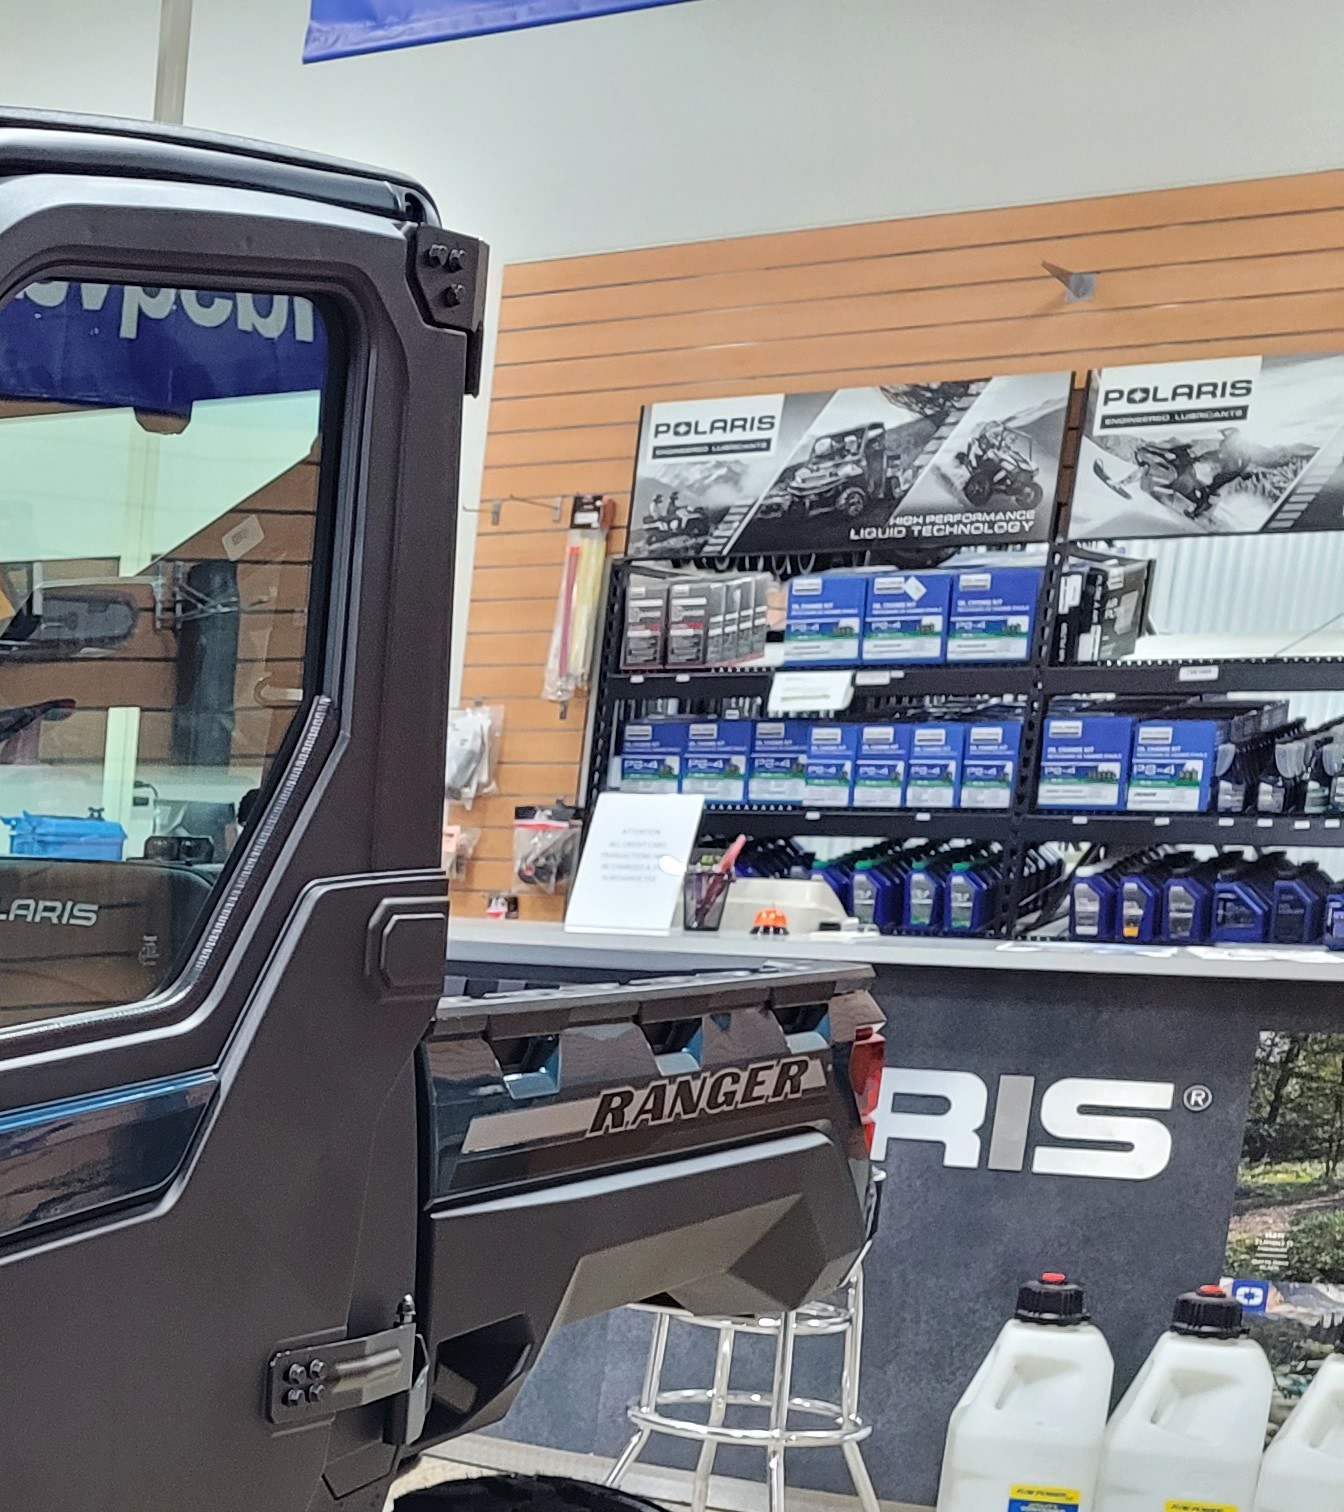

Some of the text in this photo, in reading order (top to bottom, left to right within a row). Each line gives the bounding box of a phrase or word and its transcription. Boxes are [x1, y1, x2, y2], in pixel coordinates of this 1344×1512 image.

[1102, 379, 1253, 407] POLARIS
[654, 414, 776, 438] POLARIS
[1104, 408, 1243, 426] ENGINEERED LUBRICANTS
[890, 509, 1036, 526] HIGH PERFORMANCE
[850, 520, 1035, 541] LIQUID TECHNOLOGY
[586, 1056, 812, 1138] RANGER
